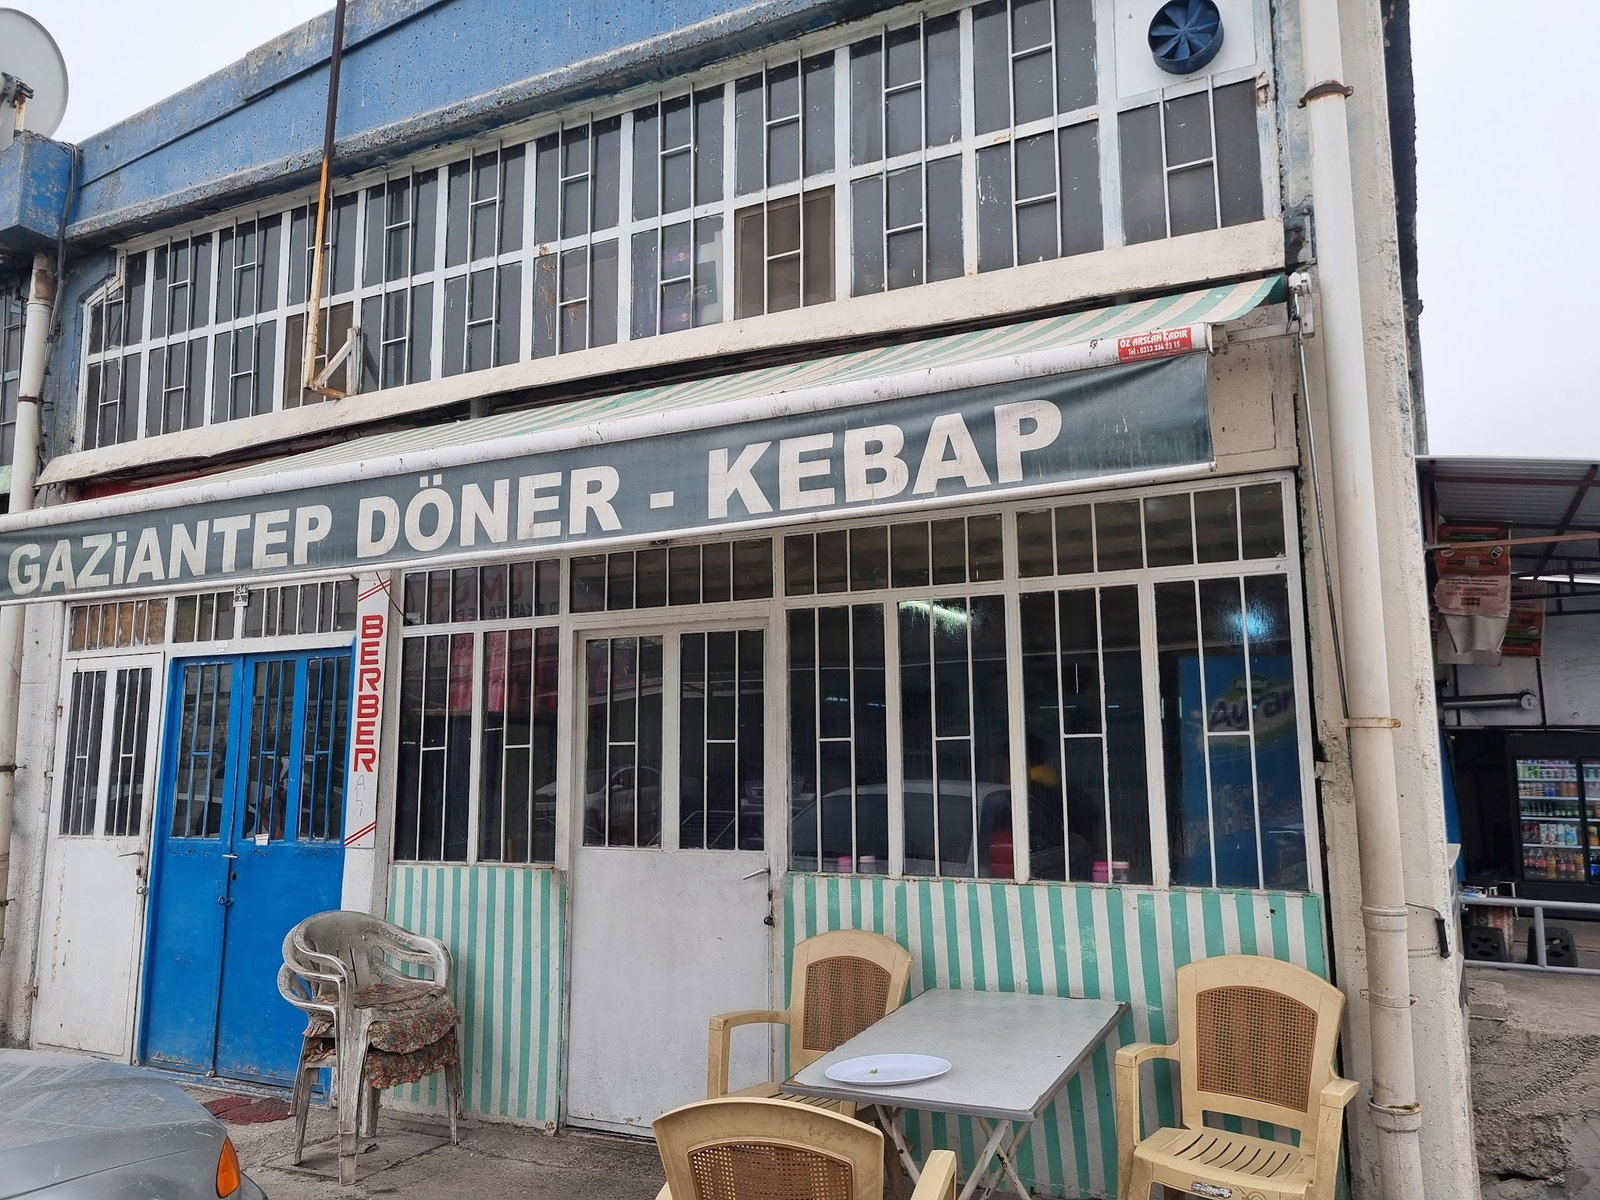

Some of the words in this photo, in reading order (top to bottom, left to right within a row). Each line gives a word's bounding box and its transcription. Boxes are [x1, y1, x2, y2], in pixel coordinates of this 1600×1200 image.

[1119, 339, 1131, 348] ÖZ
[1139, 344, 1153, 354] 0312
[356, 464, 623, 559] DÖNER
[707, 399, 1063, 520] KEBAP
[353, 614, 384, 773] BERBER
